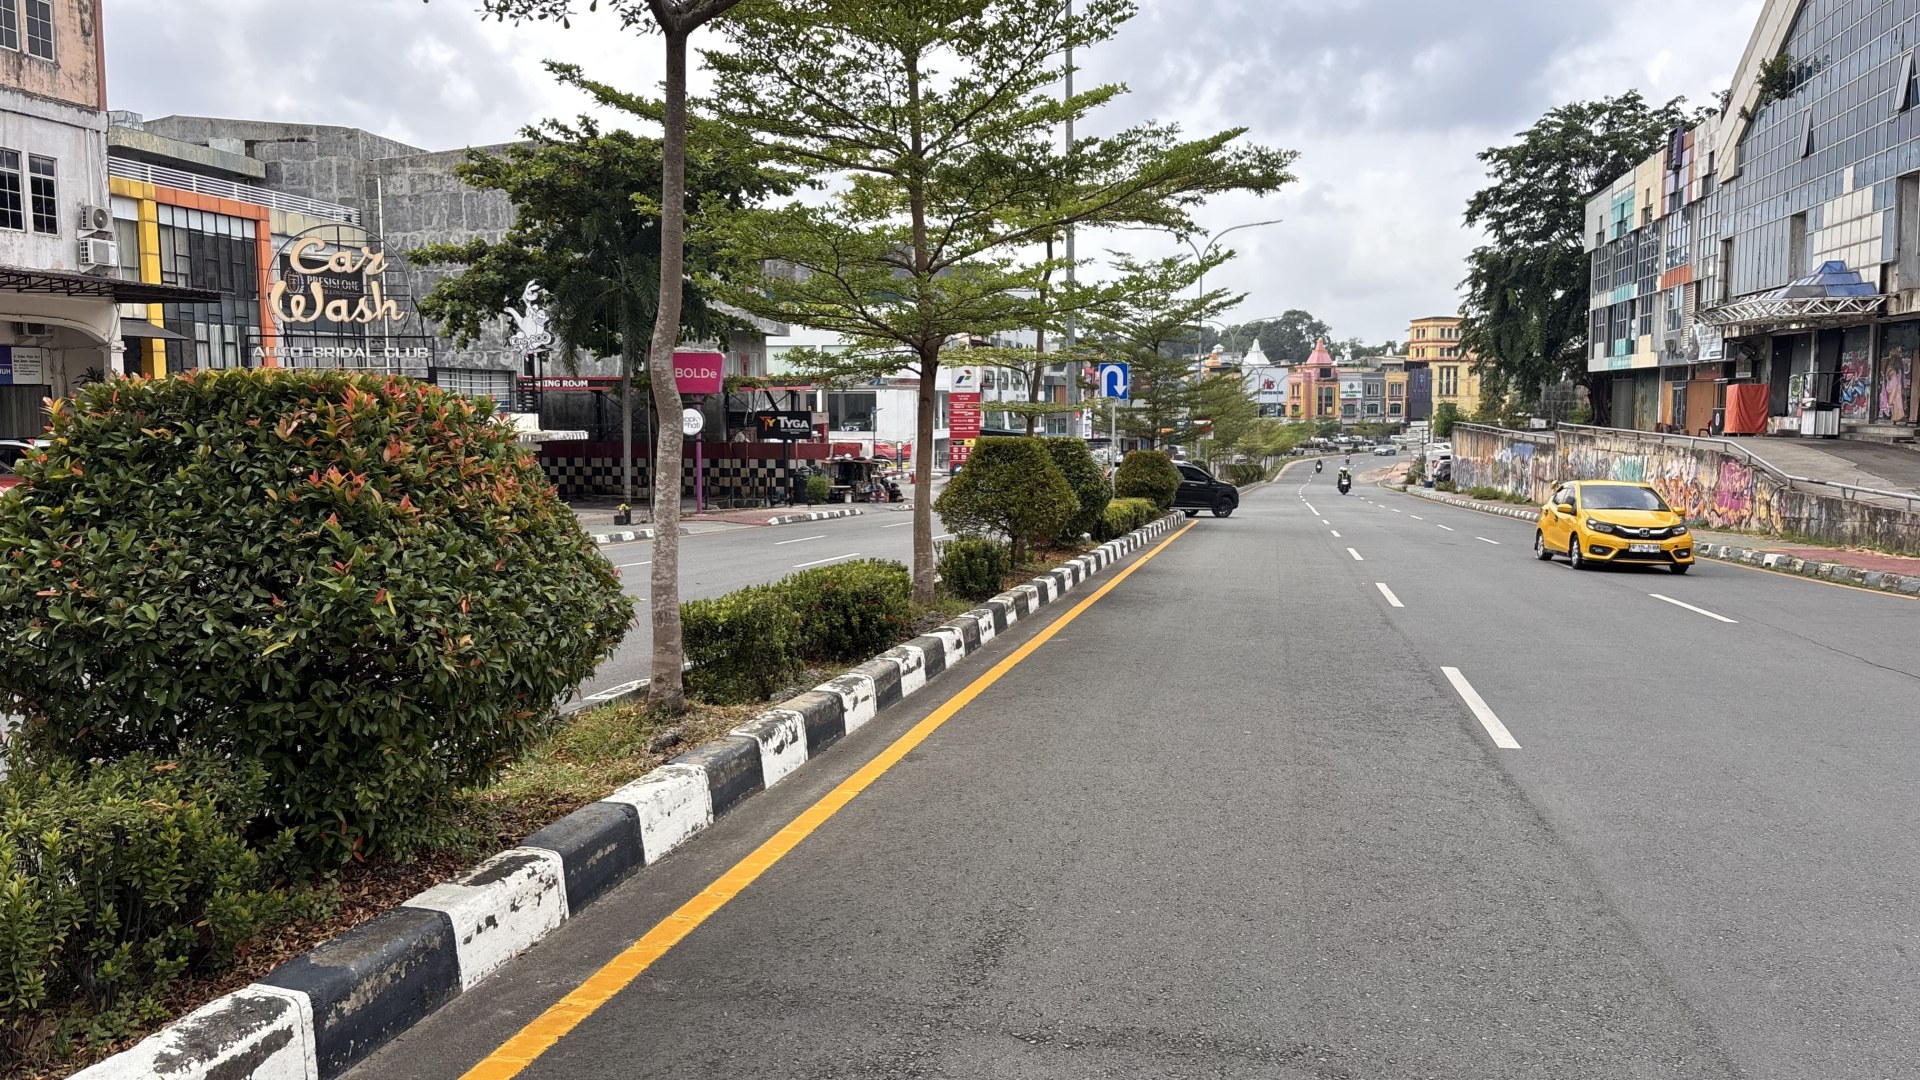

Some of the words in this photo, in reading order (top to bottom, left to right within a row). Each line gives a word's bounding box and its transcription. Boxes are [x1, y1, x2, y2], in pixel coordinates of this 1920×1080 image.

[290, 236, 389, 275] Car
[341, 279, 361, 291] ONE
[270, 280, 405, 322] Wash
[312, 347, 377, 358] BRIDAL
[384, 347, 429, 358] CLUB
[777, 416, 810, 428] TYGA
